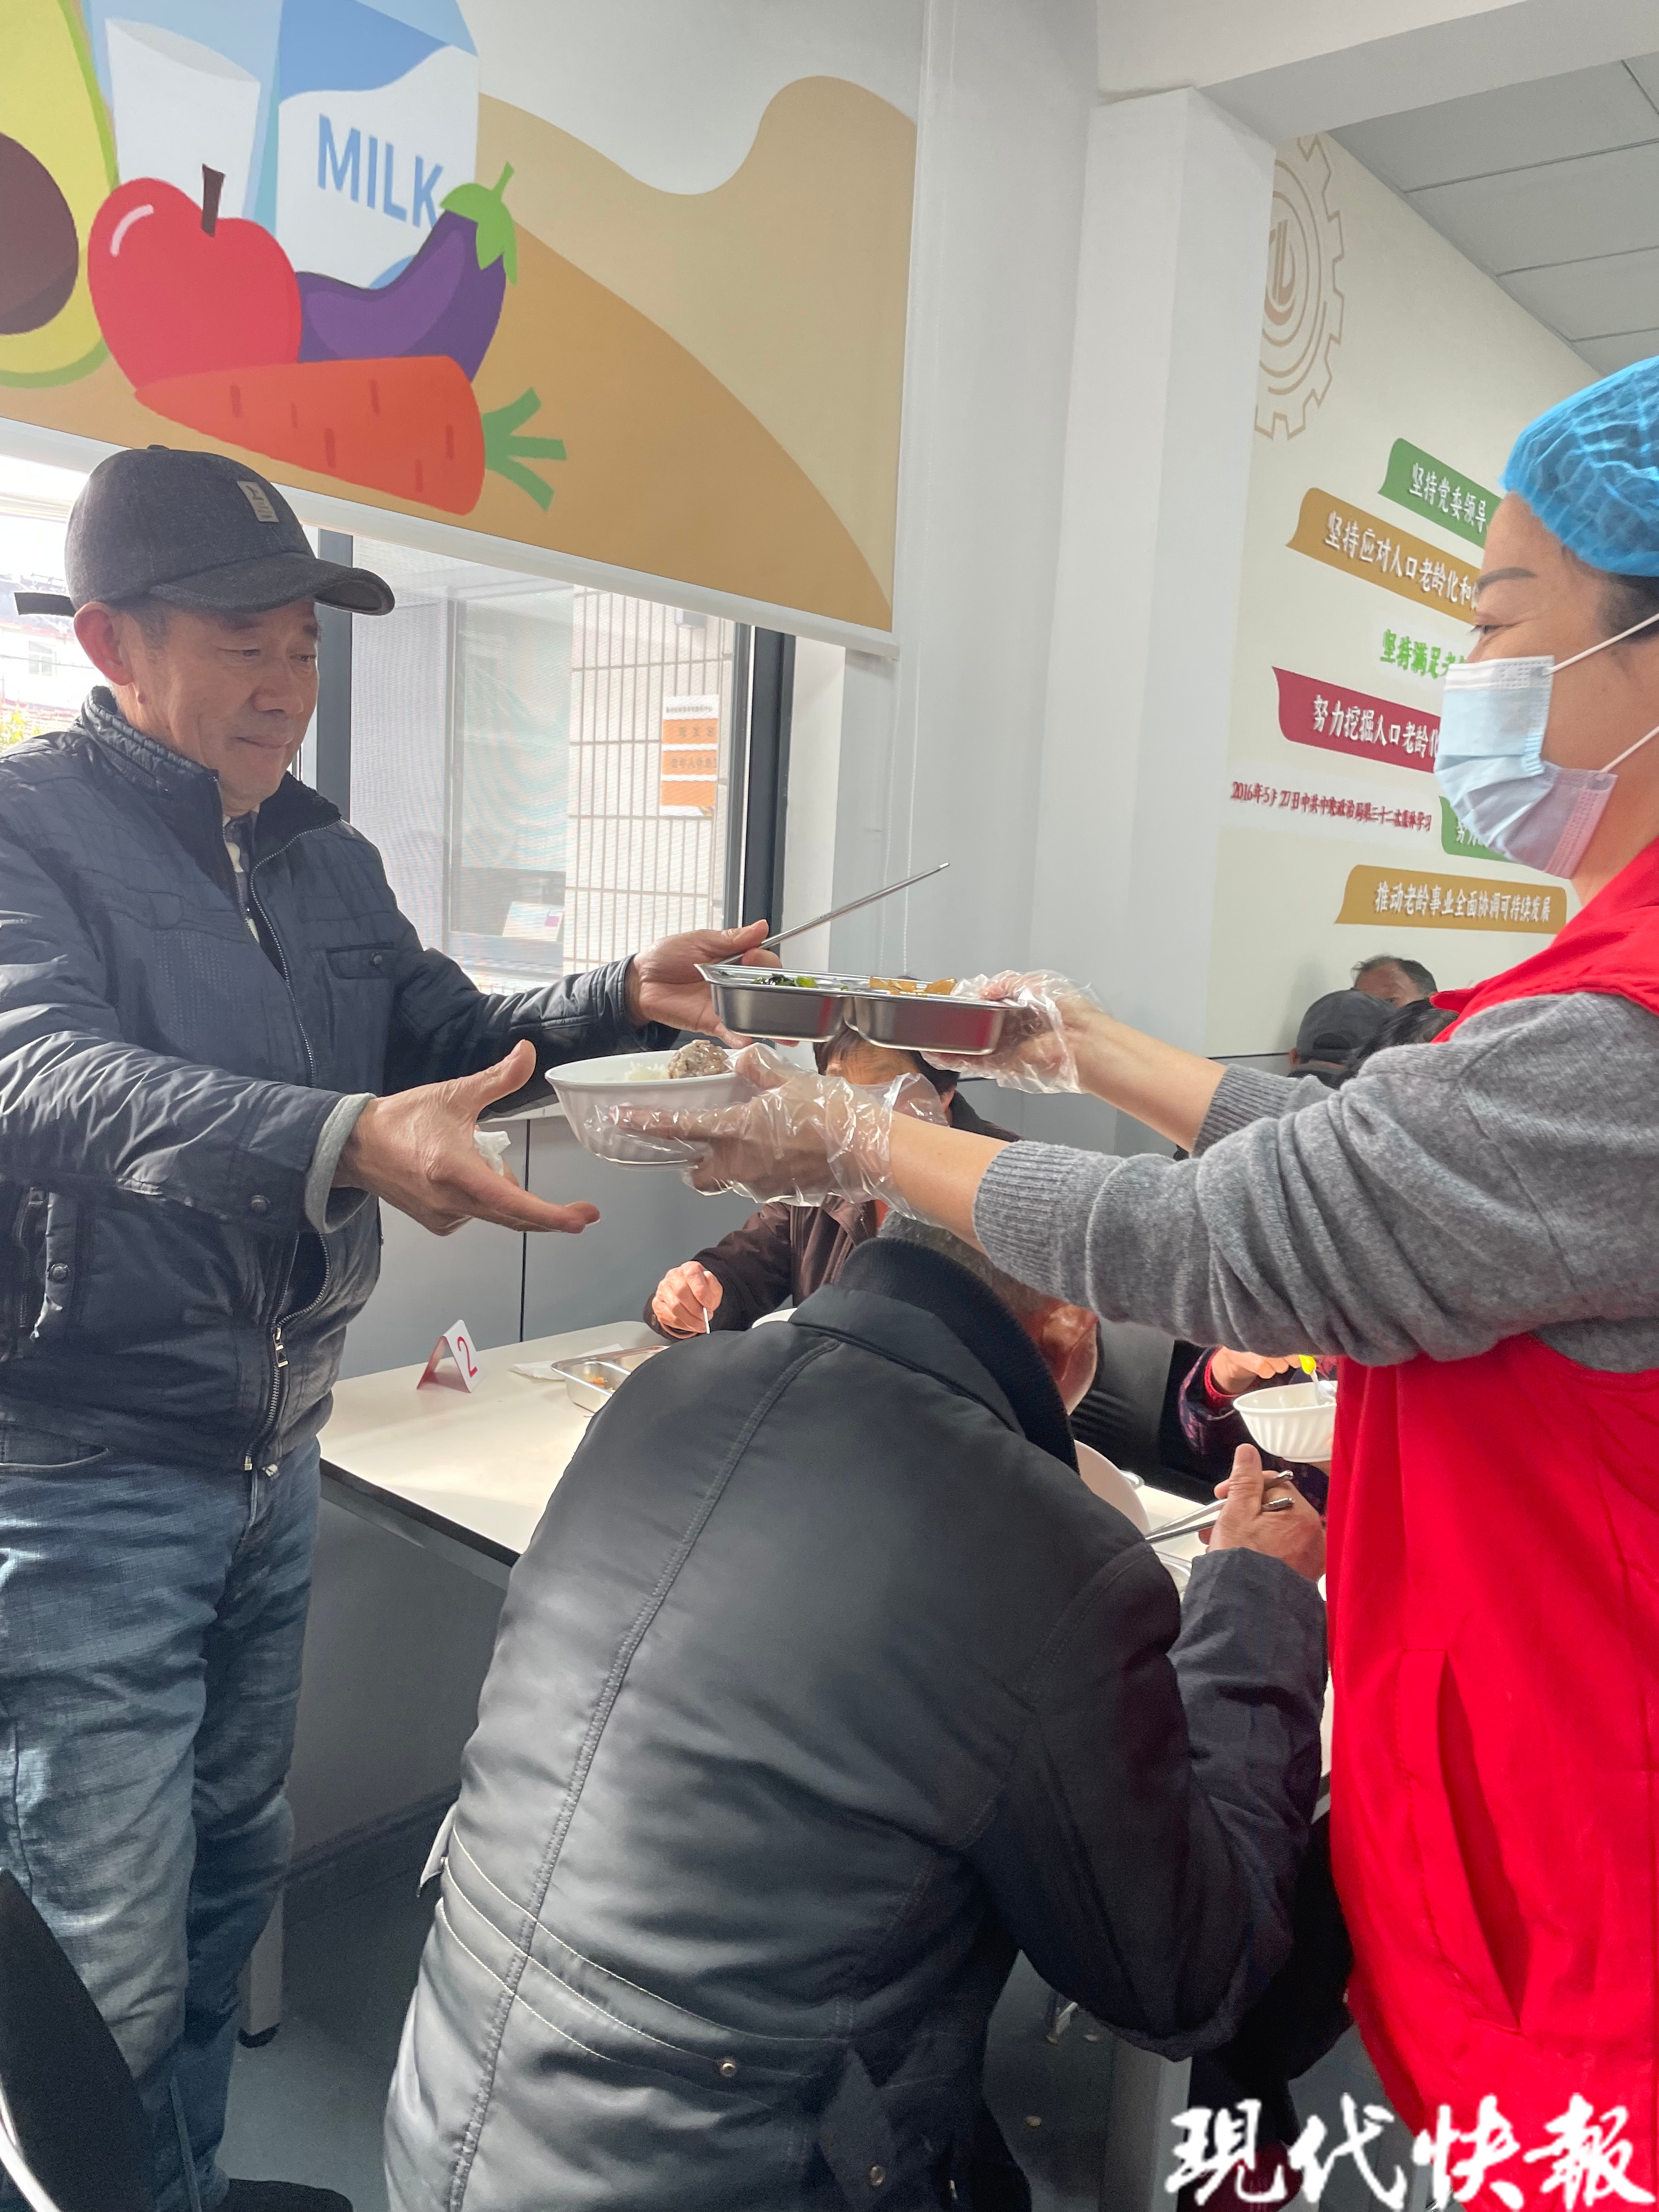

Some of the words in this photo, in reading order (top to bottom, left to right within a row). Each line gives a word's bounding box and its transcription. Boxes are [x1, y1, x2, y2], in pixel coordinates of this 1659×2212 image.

[318, 113, 443, 228] MILK
[1409, 462, 1486, 533] 坚持党委领导
[1380, 629, 1465, 679] 坚持满足老
[1375, 881, 1550, 922] 推动老龄事业全面协调可持续发展
[458, 1336, 478, 1378] 2
